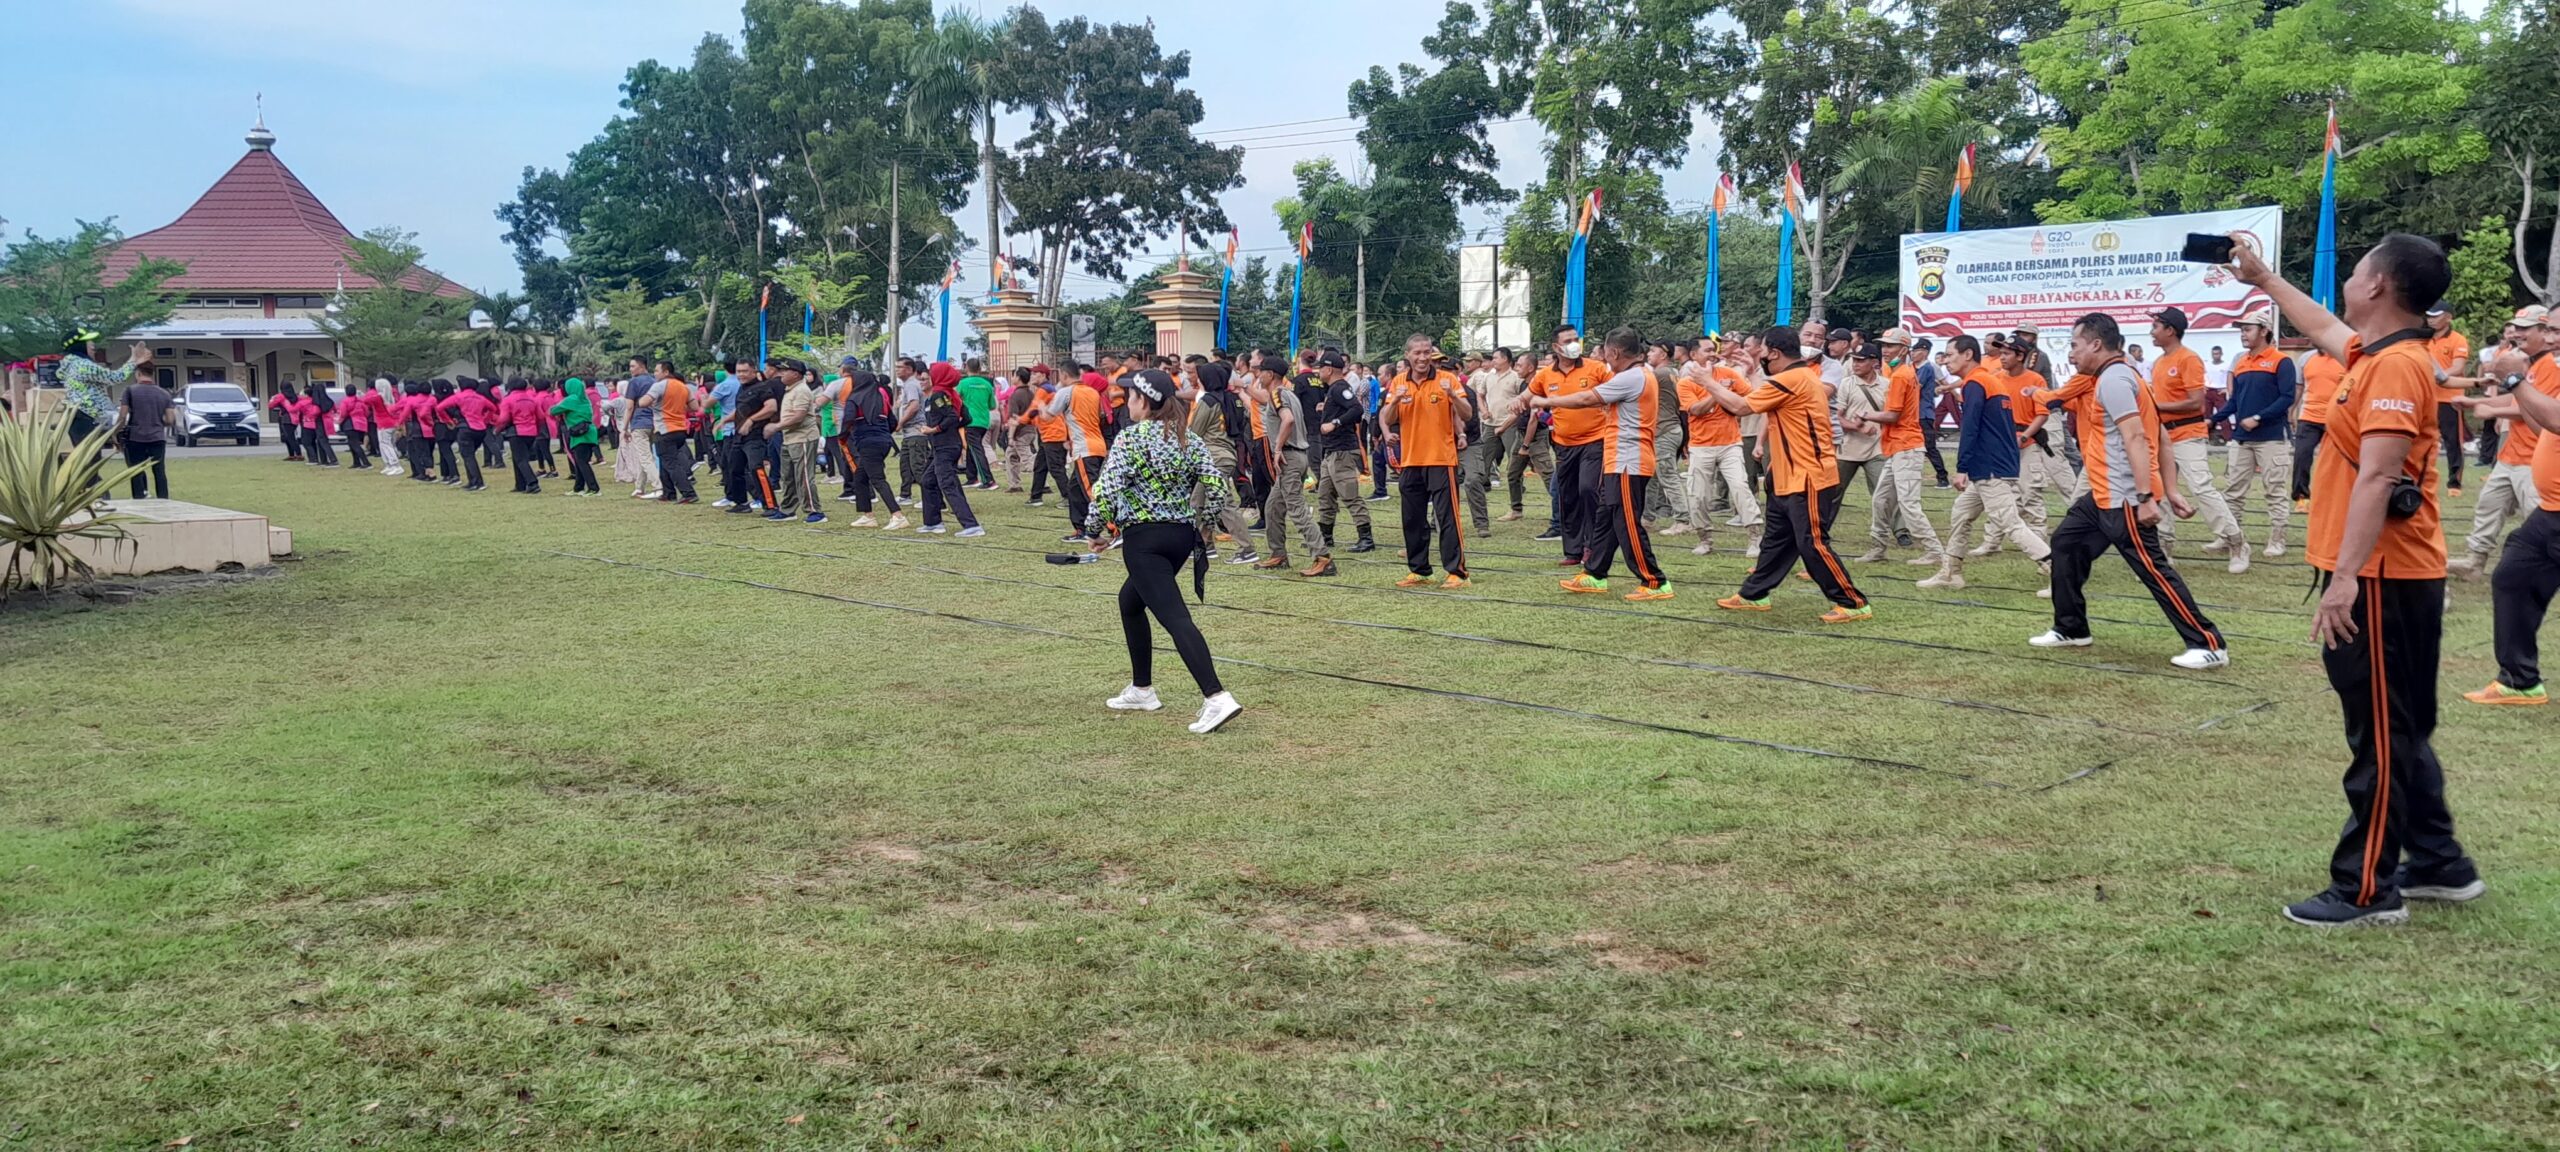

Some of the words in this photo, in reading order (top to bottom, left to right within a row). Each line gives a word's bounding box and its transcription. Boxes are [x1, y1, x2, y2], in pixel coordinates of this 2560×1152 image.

[2048, 231, 2072, 242] G20
[1956, 261, 2013, 274] OLAHRAGA
[2015, 258, 2069, 271] BERSAMA
[2071, 255, 2115, 268] POLRES
[2118, 252, 2162, 265] MUARO
[1967, 274, 2009, 284] DENGAN
[2011, 270, 2077, 282] FORKOPIMDA
[2080, 268, 2114, 278] SERTA
[2117, 266, 2149, 276] AWAK
[2153, 264, 2188, 274] MEDIA
[1987, 294, 2018, 305] HARI
[2020, 289, 2120, 305] BHAYANGKARA
[1132, 373, 1163, 402] adidas
[2371, 398, 2416, 413] POLICE
